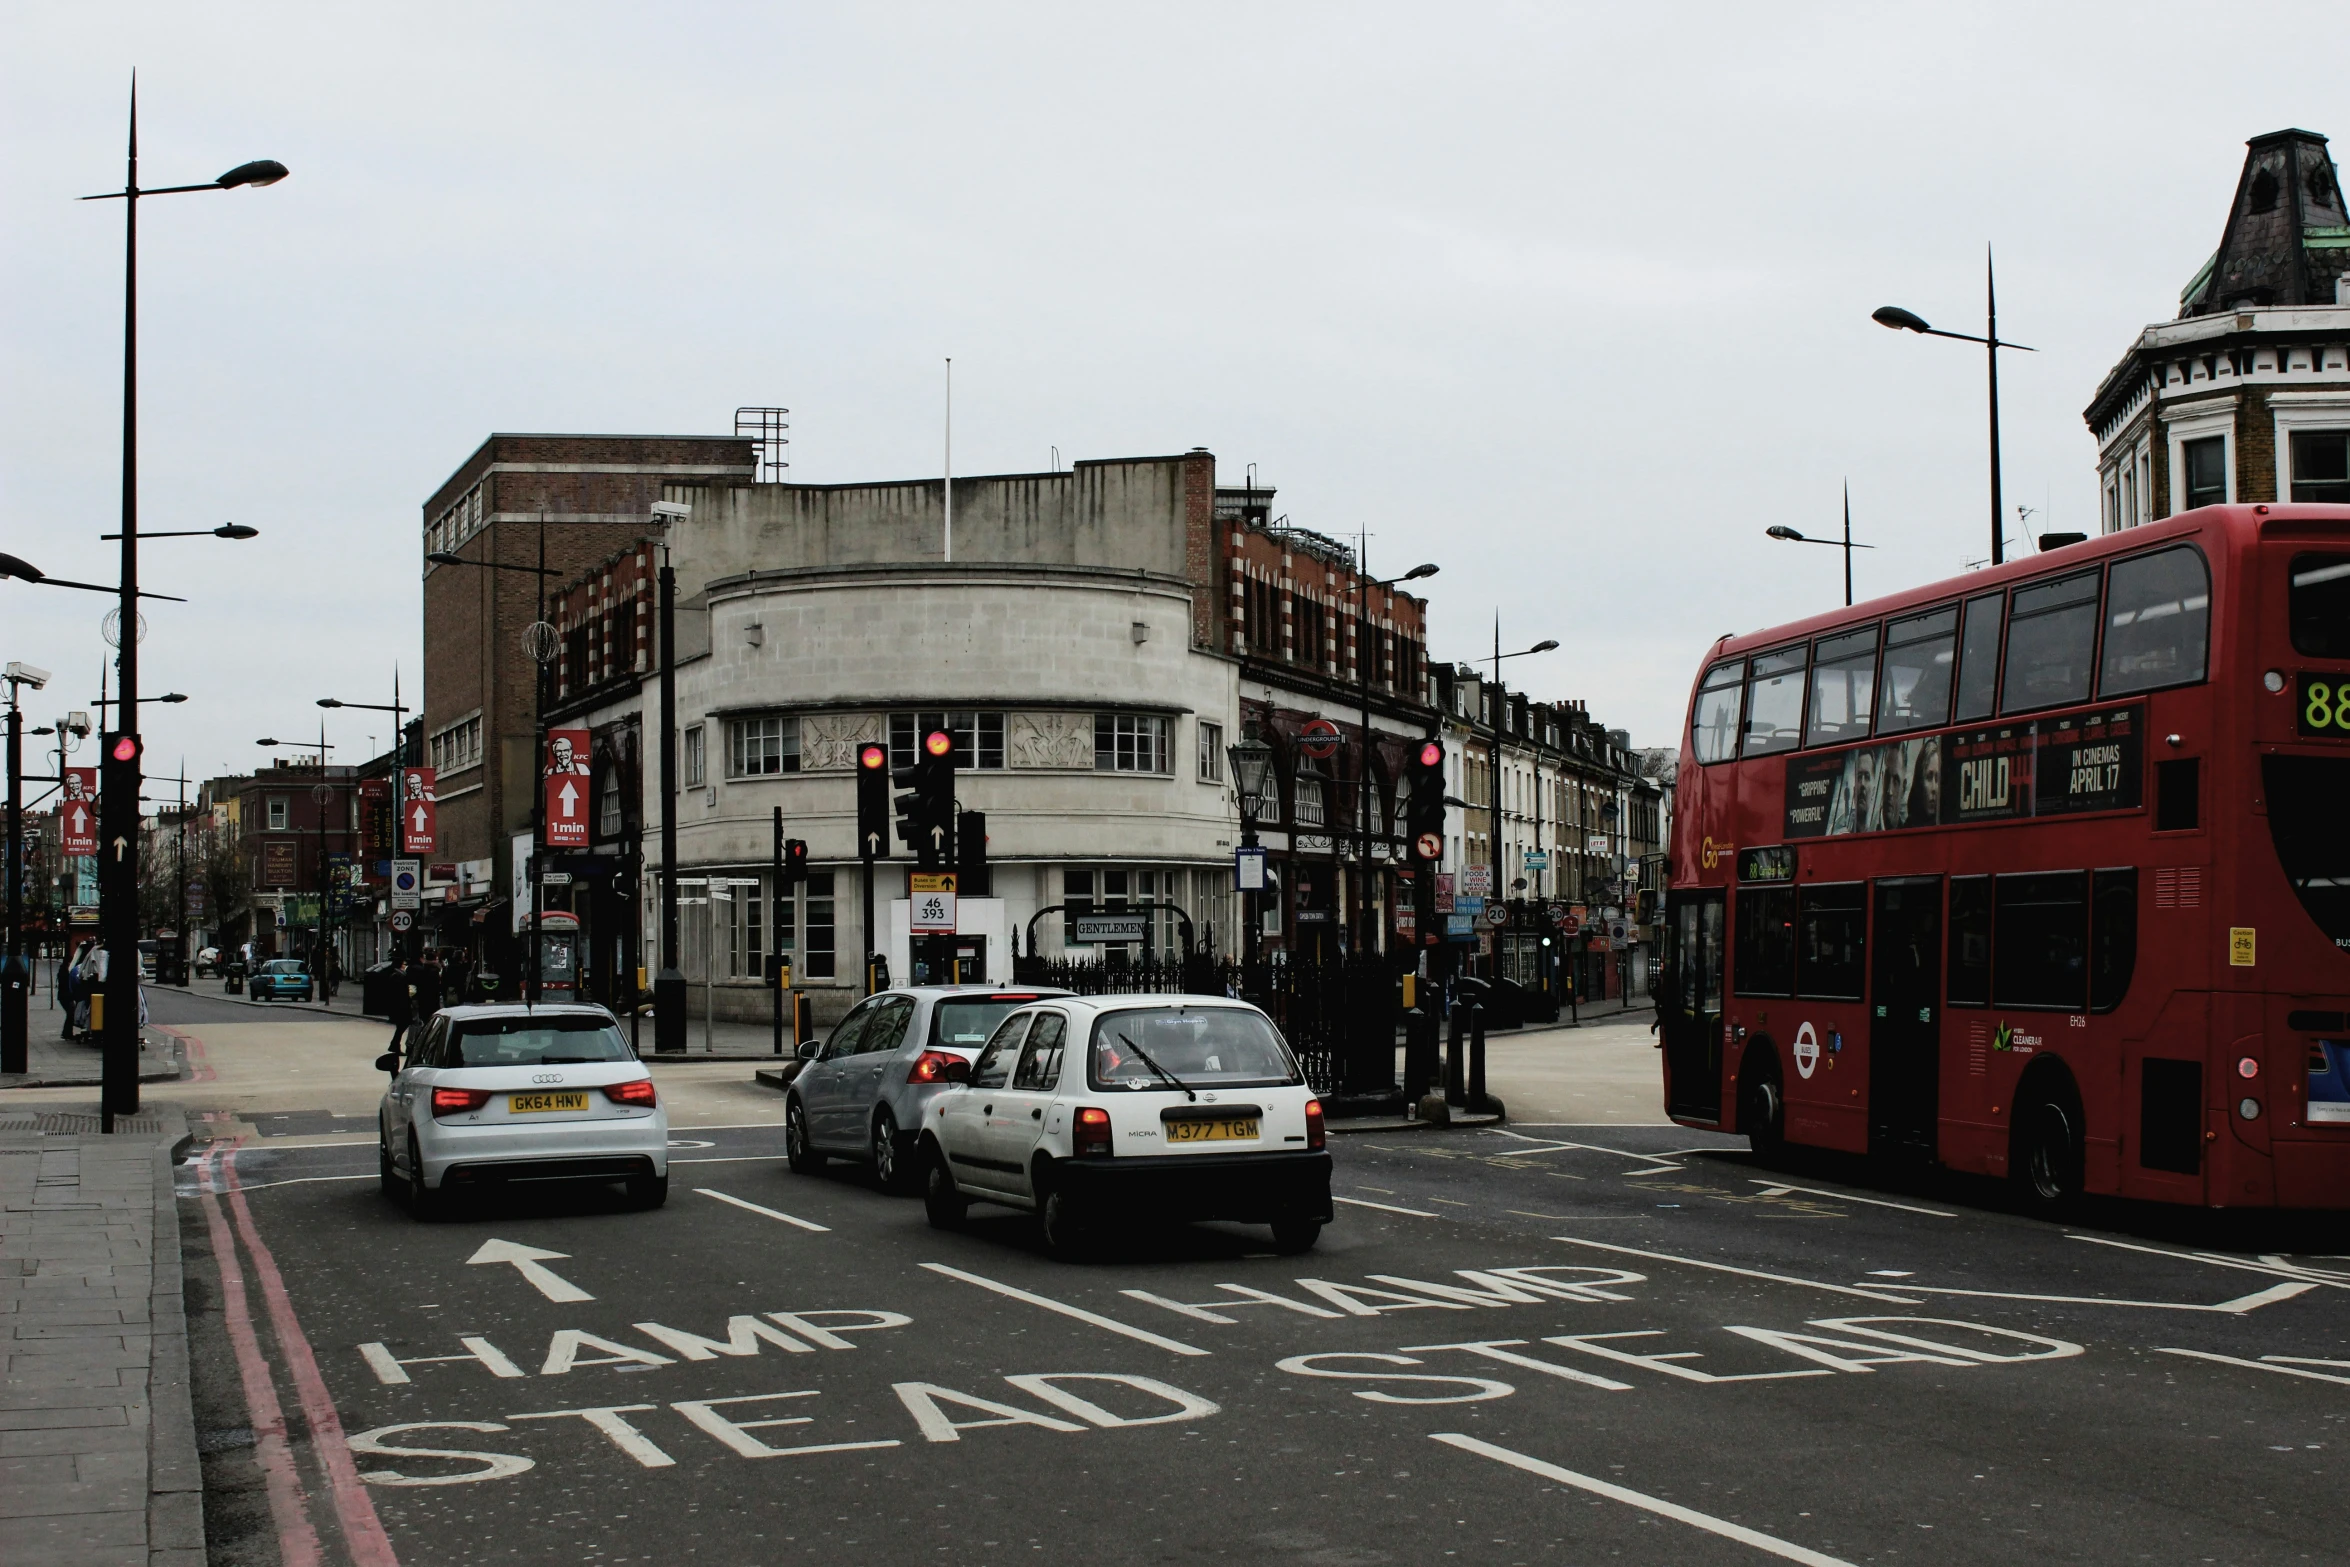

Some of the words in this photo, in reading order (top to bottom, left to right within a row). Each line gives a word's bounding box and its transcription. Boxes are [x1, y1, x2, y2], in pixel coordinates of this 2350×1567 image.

[2305, 681, 2350, 730] 88
[1243, 753, 1265, 761] TAXI
[2072, 749, 2082, 767] IN
[2083, 744, 2120, 766] CINEMAS
[2070, 766, 2103, 794] APRIL
[2106, 764, 2120, 790] 17
[373, 807, 381, 848] TATTOO
[552, 822, 558, 833] 1
[560, 822, 585, 833] min
[67, 837, 72, 845] 1
[73, 837, 93, 845] min
[408, 835, 413, 843] 1
[414, 834, 432, 844] min
[1702, 836, 1718, 869] Go
[1749, 862, 1758, 879] 88
[926, 898, 941, 908] 46
[922, 908, 944, 919] 393
[1490, 910, 1505, 919] 20
[1550, 910, 1562, 919] 20
[394, 916, 410, 926] 20
[1078, 923, 1145, 934] GENTLEMEN
[2070, 1015, 2086, 1027] EH26
[1801, 1046, 1811, 1054] BUSES
[515, 1096, 550, 1111] GK64
[555, 1095, 583, 1108] HNV
[1167, 1122, 1214, 1139] M377
[1221, 1121, 1258, 1137] TGM
[1119, 1266, 1648, 1324] HAMP
[357, 1309, 914, 1384] HAMP
[1276, 1315, 2085, 1404] STEAD
[347, 1372, 1222, 1486] STEAD
